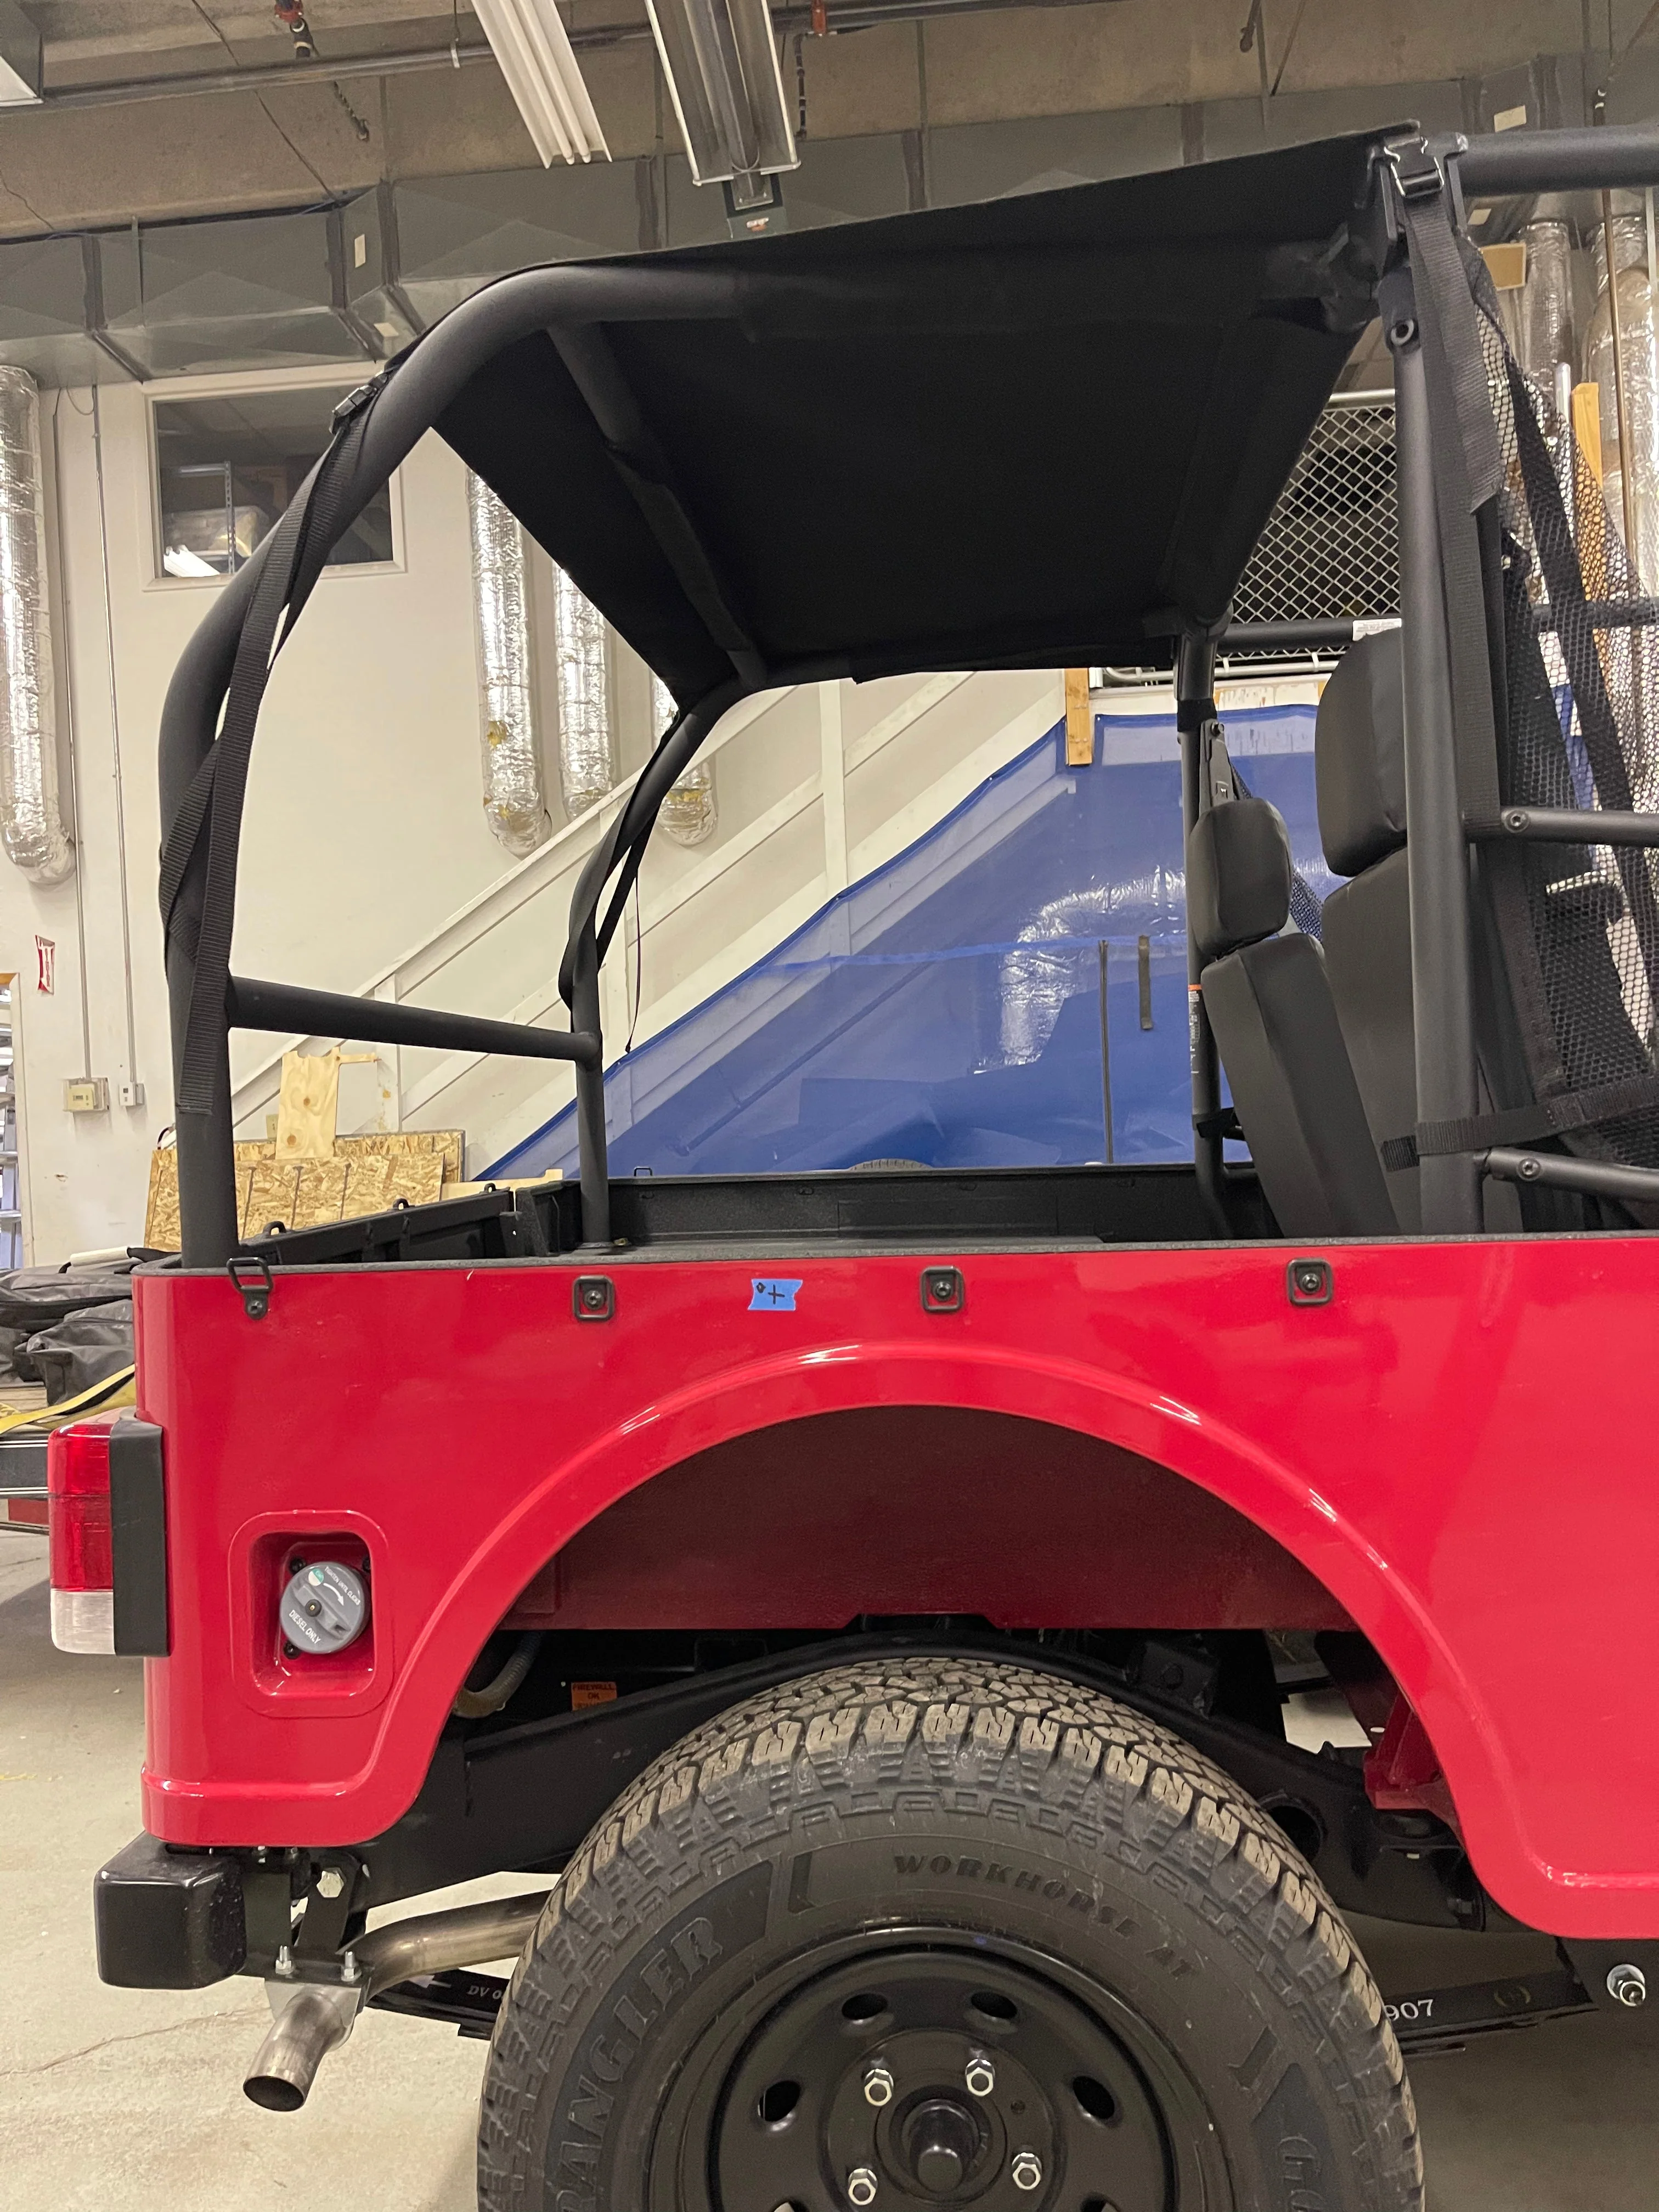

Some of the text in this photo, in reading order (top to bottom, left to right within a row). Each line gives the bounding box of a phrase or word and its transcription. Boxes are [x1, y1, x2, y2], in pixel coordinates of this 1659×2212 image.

[289, 1610, 321, 1644] DIESEL ONLY
[894, 1854, 1141, 1938] WORKHORSE
[467, 1985, 490, 1997] DV
[1384, 1999, 1435, 2022] 907
